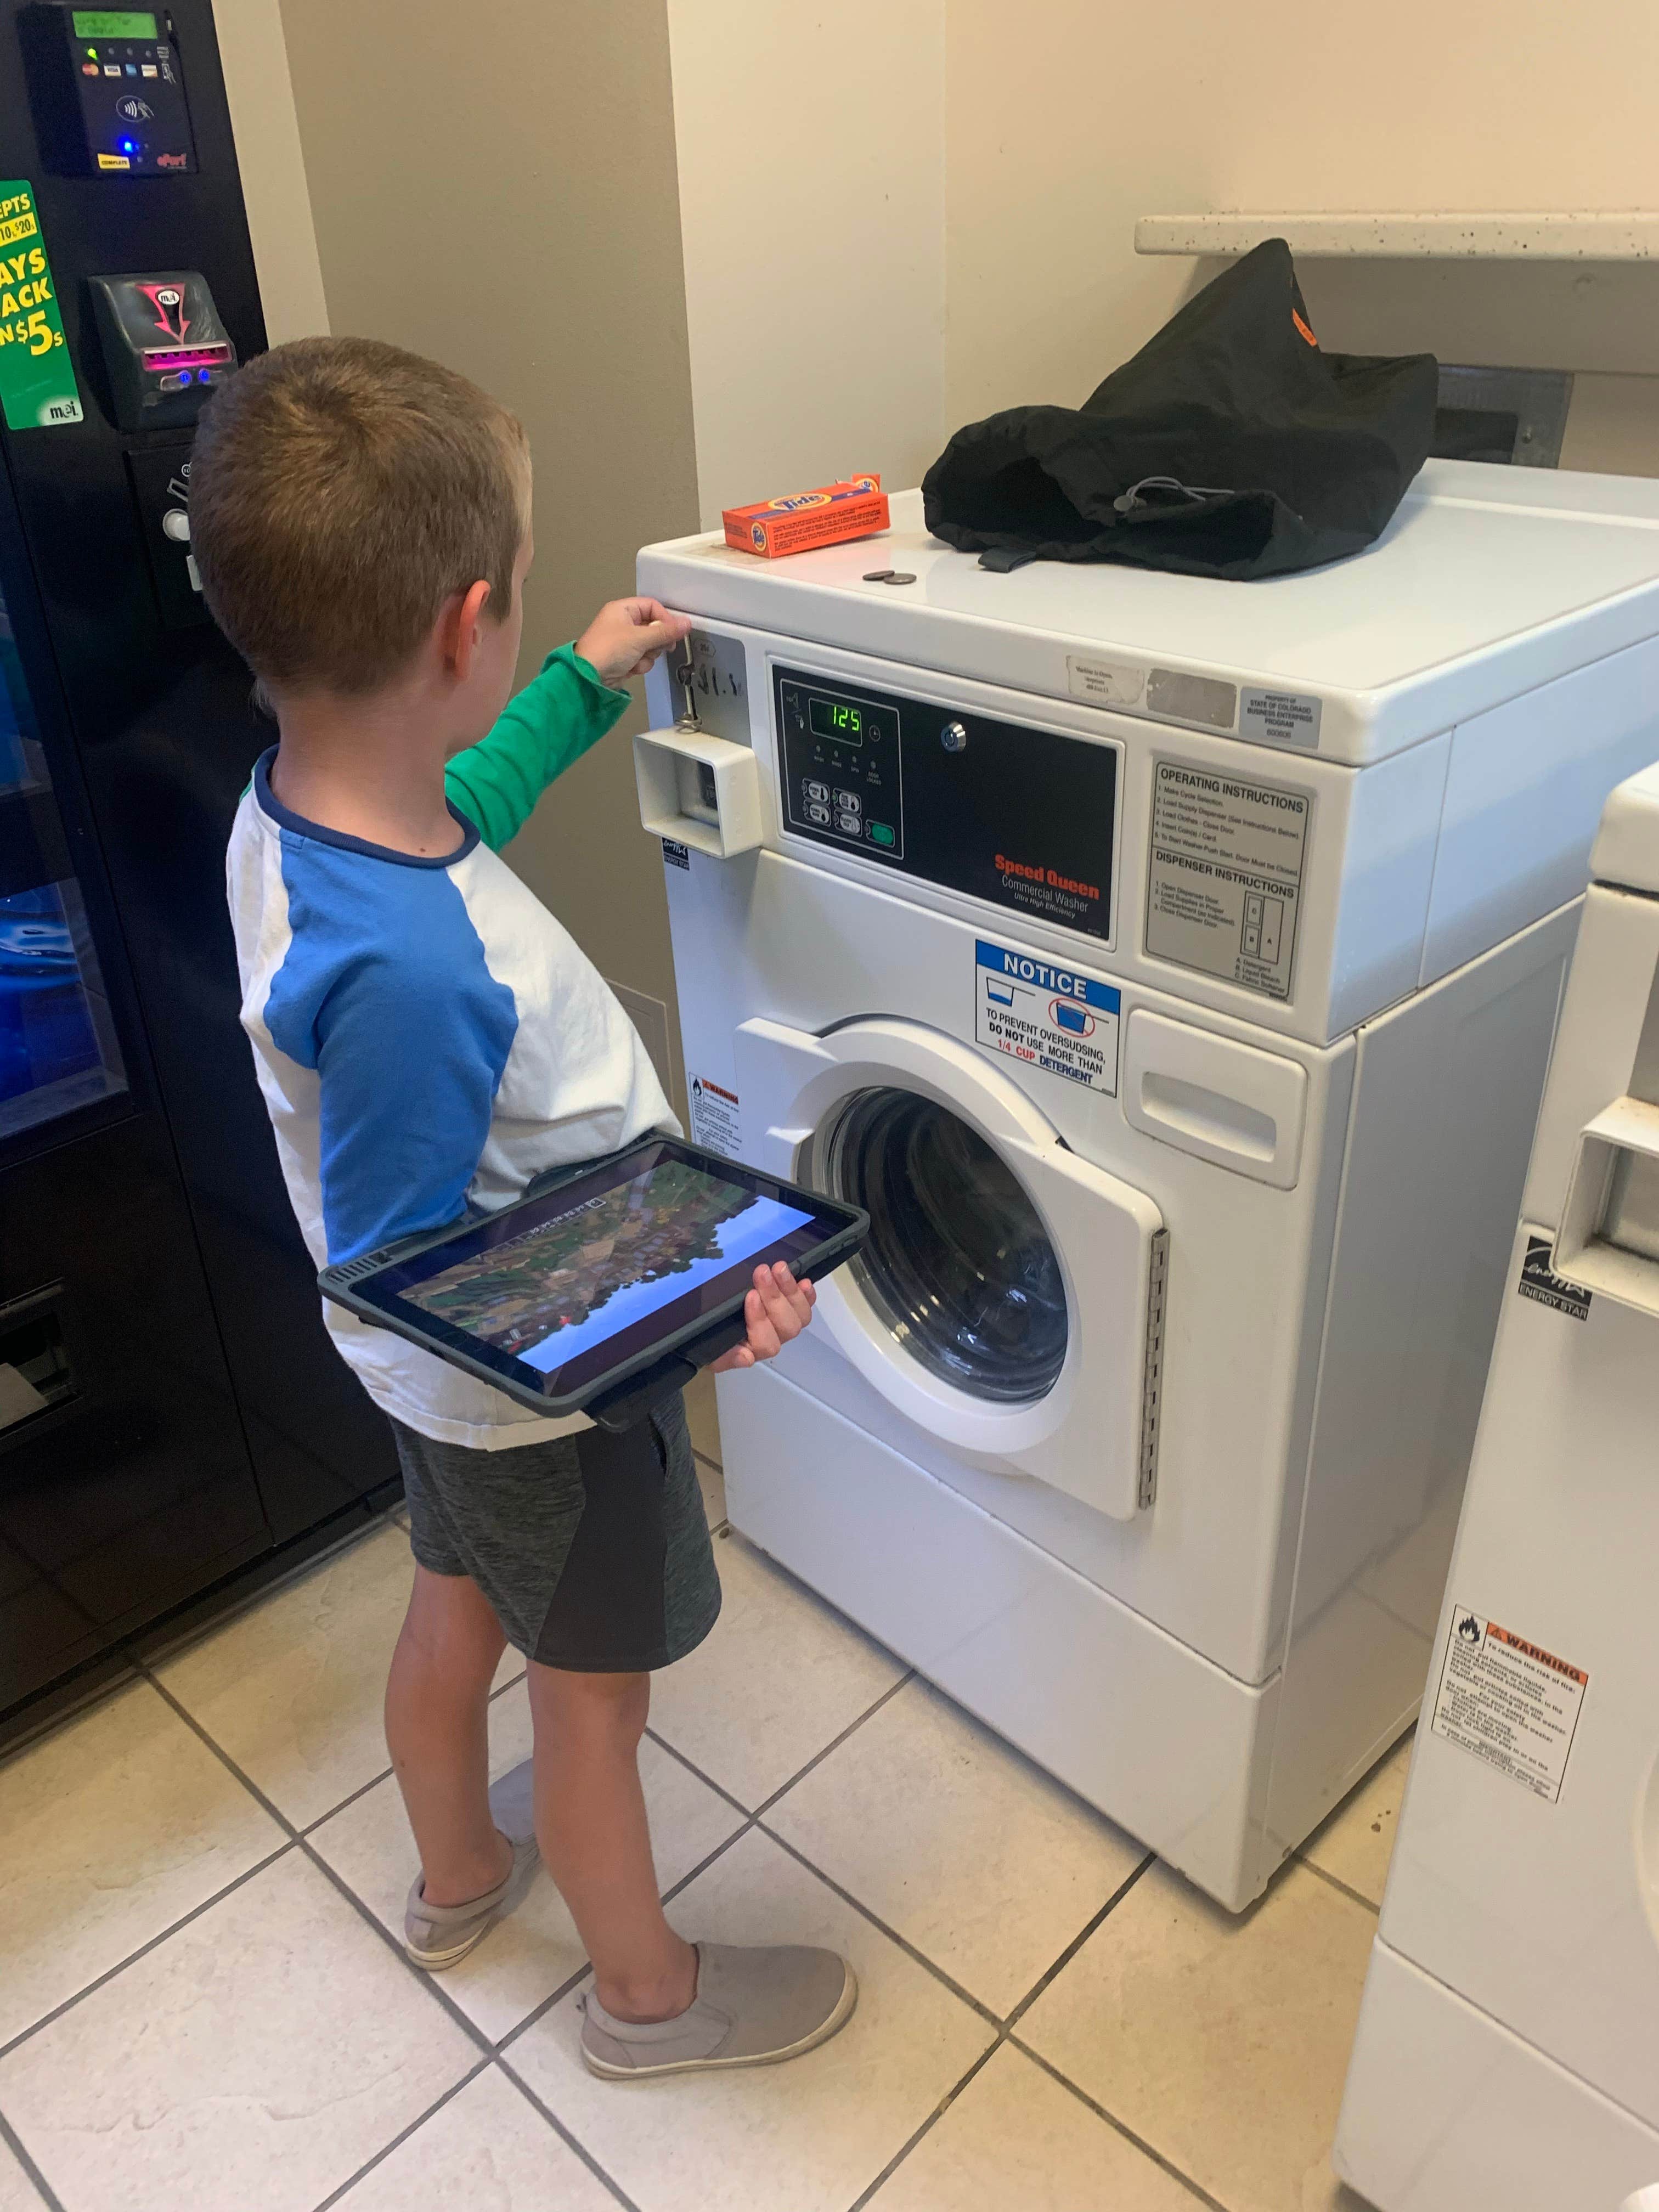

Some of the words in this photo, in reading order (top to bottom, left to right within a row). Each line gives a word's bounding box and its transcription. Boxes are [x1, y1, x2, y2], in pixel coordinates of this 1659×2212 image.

[774, 495, 822, 510] Tide
[752, 528, 765, 545] Tide
[833, 706, 860, 732] 125
[1247, 707, 1276, 717] BUSINESS
[1277, 711, 1313, 724] ENTERPRISE
[1250, 699, 1267, 708] STATE
[1278, 703, 1312, 714] COLORADO
[1265, 718, 1294, 728] PROGRAM
[1161, 768, 1220, 793] OPERATING
[1223, 783, 1304, 813] INSTRUCTIONS
[995, 854, 1044, 883] Speed
[1047, 870, 1099, 900] Queen
[1002, 874, 1052, 901] Commercial
[1055, 891, 1088, 913] Washer
[1156, 851, 1212, 876] DISPENSER
[1216, 869, 1294, 899] INSTRUCTIONS
[1014, 892, 1028, 903] Ultra
[1029, 898, 1043, 909] High
[1045, 902, 1075, 919] Efficiency
[1004, 953, 1087, 1000] NOTICE
[986, 1007, 997, 1020] TO
[999, 1013, 1038, 1035] PREVENT
[1040, 1029, 1105, 1065] OVERSUDSING,
[989, 1023, 1002, 1035] DO
[1005, 1028, 1025, 1043] NOT
[1026, 1035, 1044, 1052] USE
[1048, 1046, 1074, 1064] MORE
[1077, 1057, 1103, 1075] THAN
[998, 1039, 1011, 1052] 1/4
[1016, 1045, 1035, 1061] CUP
[1039, 1056, 1093, 1085] DETERGENT
[1520, 1284, 1559, 1306] ENERGY
[1560, 1304, 1588, 1321] STAR
[1507, 1635, 1580, 1682] WARNING
